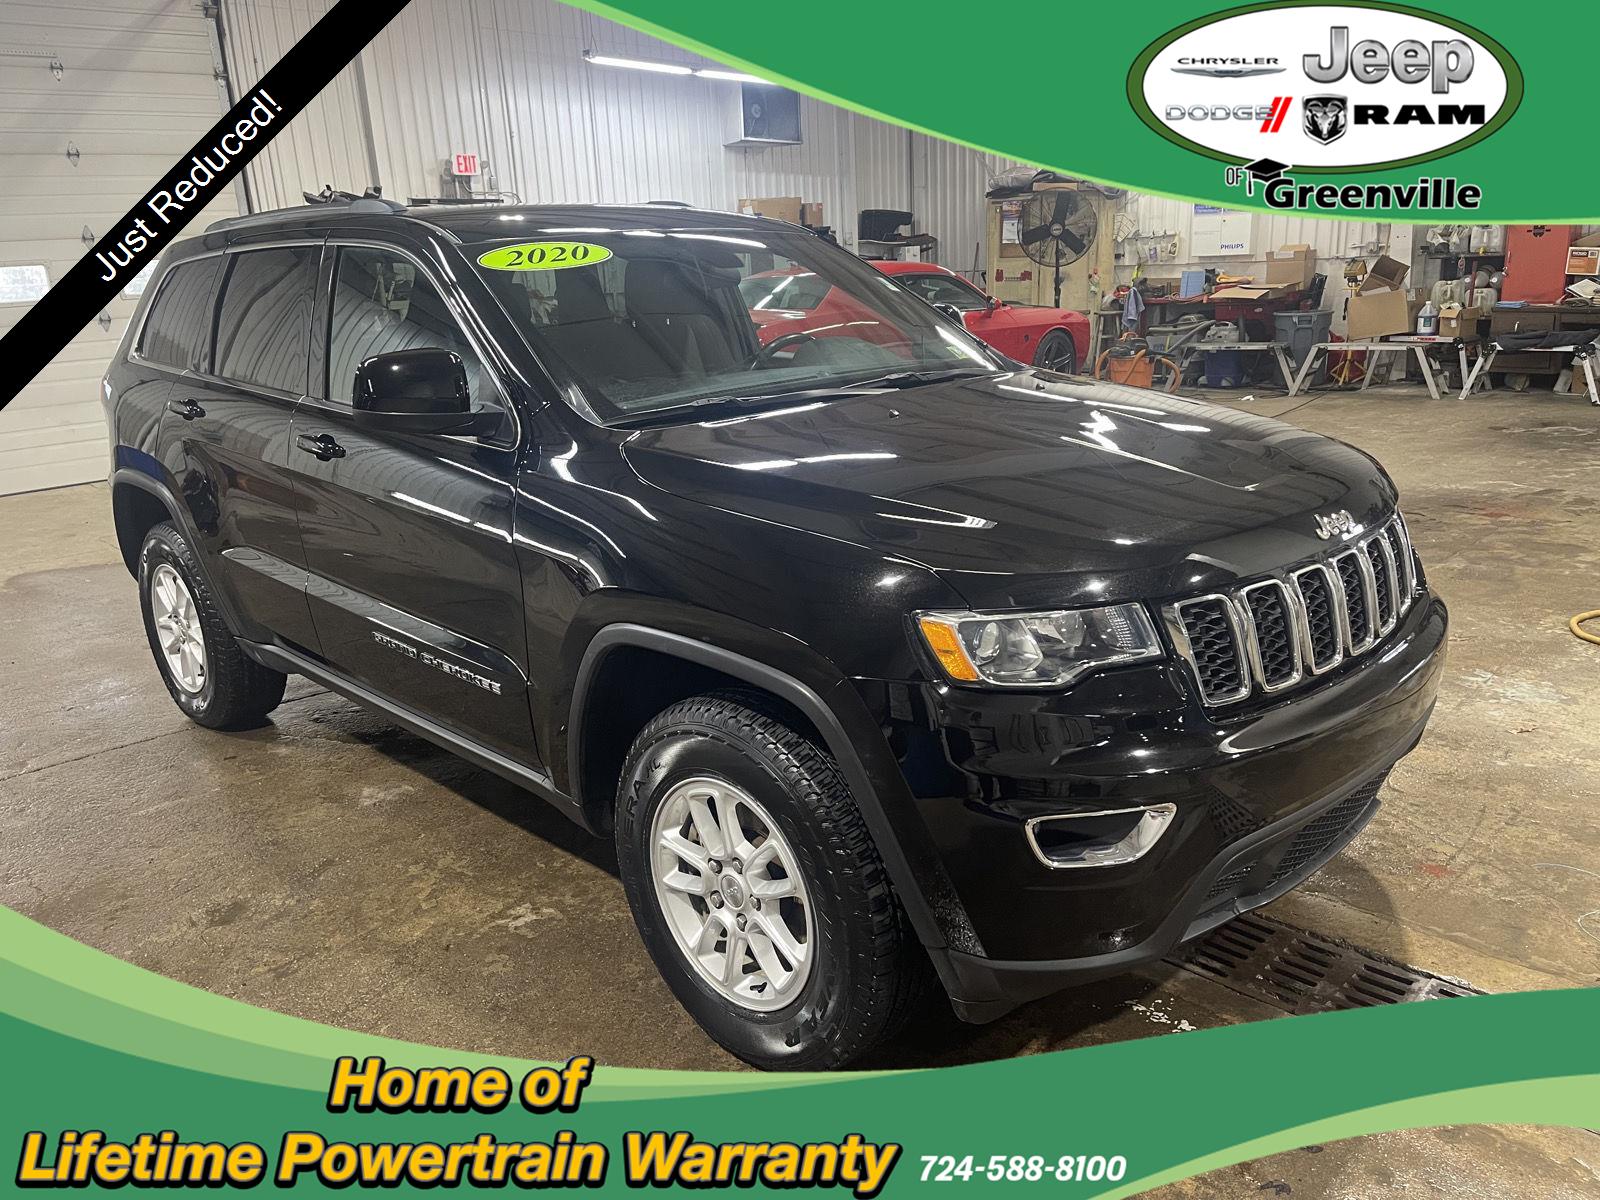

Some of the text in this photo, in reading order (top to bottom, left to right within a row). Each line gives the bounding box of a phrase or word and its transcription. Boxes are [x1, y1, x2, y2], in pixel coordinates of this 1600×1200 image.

[456, 154, 477, 173] EXIT
[505, 245, 590, 268] 2020
[1313, 509, 1357, 541] Jeep
